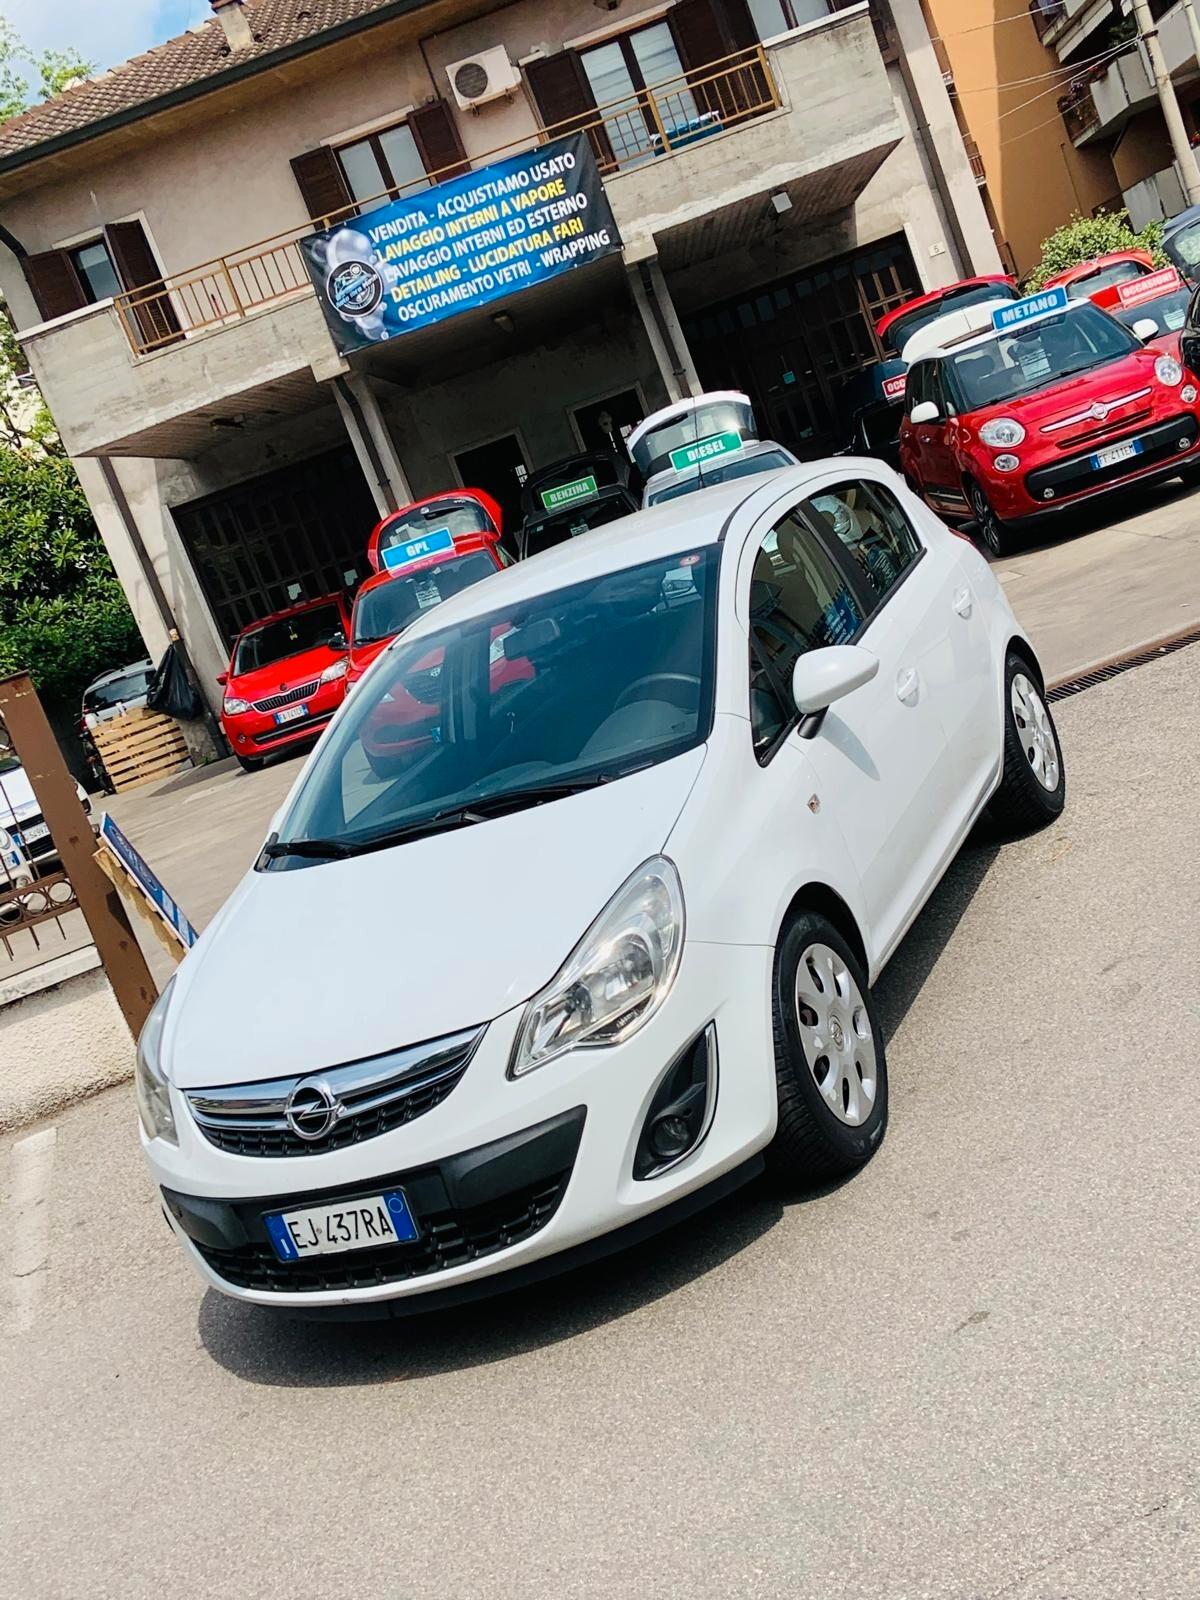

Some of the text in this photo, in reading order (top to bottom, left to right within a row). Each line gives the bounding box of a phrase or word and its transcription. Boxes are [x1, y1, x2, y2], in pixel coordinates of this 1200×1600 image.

[368, 210, 429, 243] VENDITA
[437, 171, 529, 219] ACQUISTIAMO
[529, 153, 576, 182] USATO
[375, 178, 567, 264] LAVAGGIO INTERNI A VAPORE
[384, 246, 452, 283] LAVAGGIO
[452, 225, 507, 258] INTERNI
[506, 218, 525, 237] ED
[526, 192, 588, 229] ESTERNO
[391, 264, 461, 303] DETAILING
[468, 230, 554, 274] LUCIDATURA
[552, 217, 585, 241] FARI
[398, 274, 494, 321] OSCURAMENTO
[493, 260, 532, 285] VETRI
[540, 229, 611, 268] WRAPPING
[1001, 294, 1058, 324] METANO
[549, 482, 590, 503] BENZINA
[686, 440, 726, 462] DIESEL
[406, 541, 430, 557] GPL
